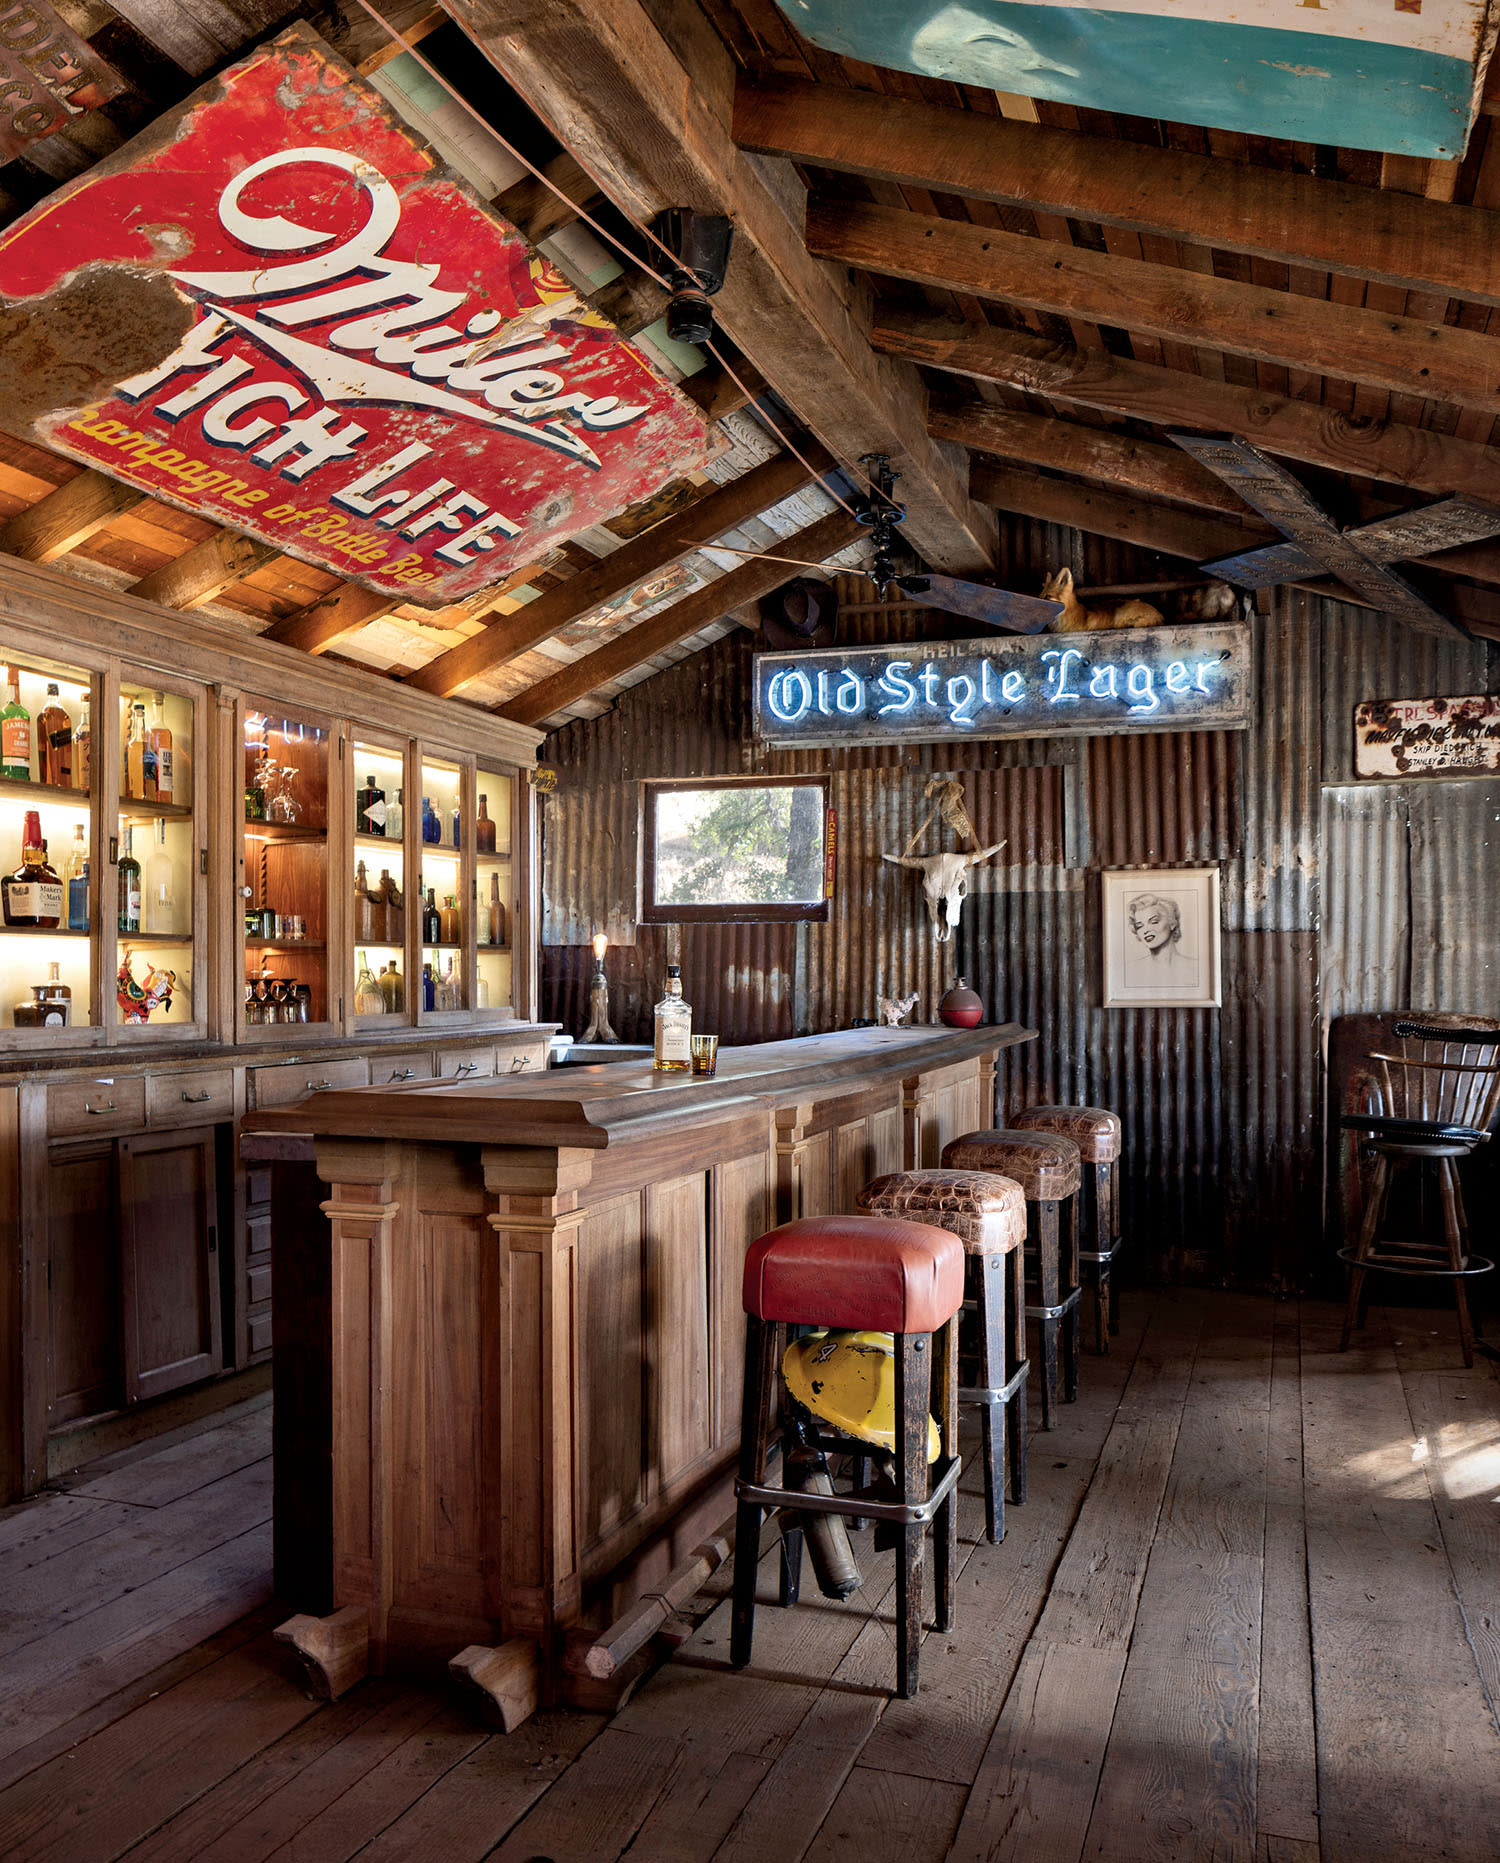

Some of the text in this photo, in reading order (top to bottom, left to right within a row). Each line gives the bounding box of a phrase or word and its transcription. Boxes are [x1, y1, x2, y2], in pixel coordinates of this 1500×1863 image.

[165, 146, 652, 434] Miller
[68, 400, 446, 593] hampagne of Bottle Beer
[329, 439, 522, 568] LIFE
[767, 648, 1222, 724] Old Style Lager
[1413, 745, 1431, 754] SKIP
[828, 822, 836, 855] CAMELS
[817, 1343, 839, 1364] 4
